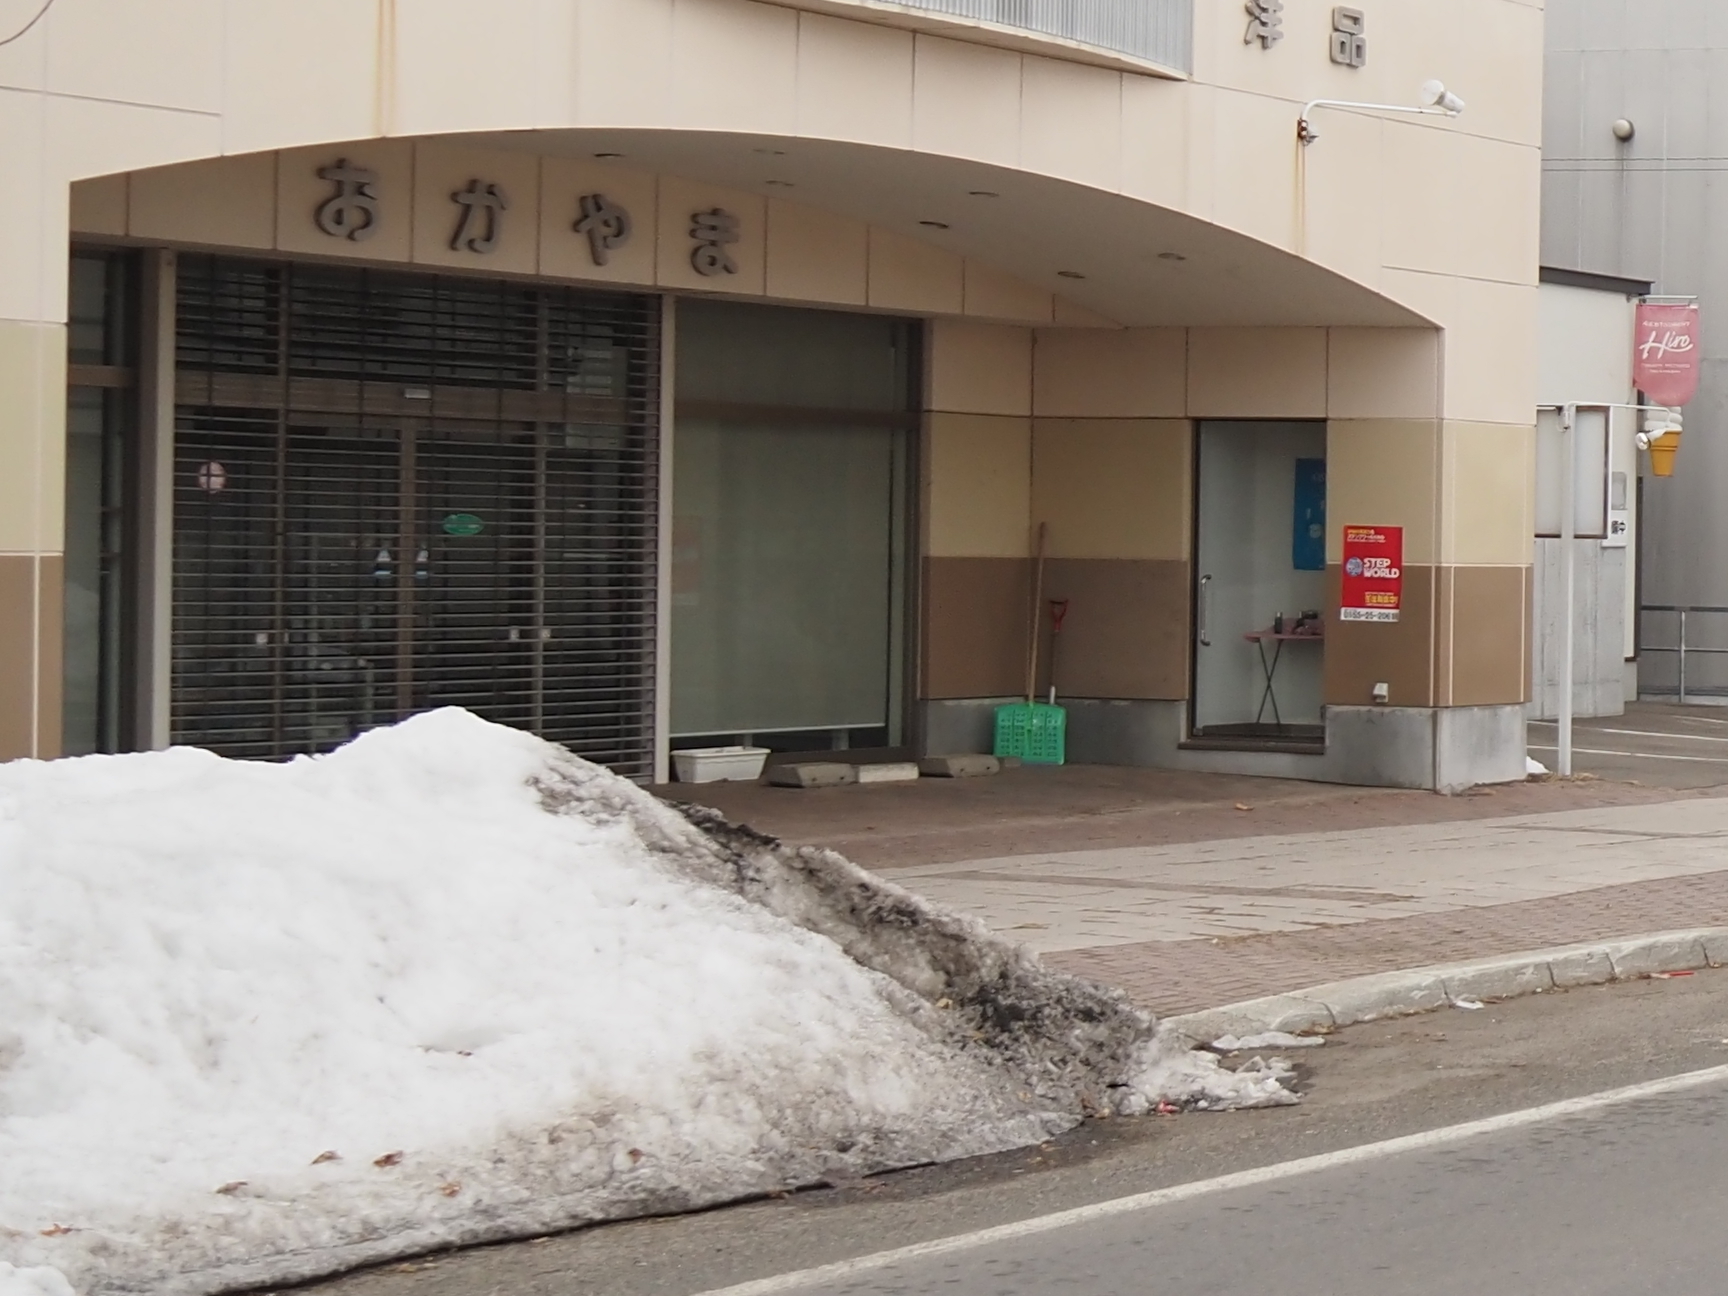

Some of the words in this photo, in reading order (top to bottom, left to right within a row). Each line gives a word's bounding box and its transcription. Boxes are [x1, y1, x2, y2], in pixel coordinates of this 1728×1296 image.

[1639, 331, 1694, 359] Hiro
[1363, 558, 1391, 568] STEP
[1363, 568, 1399, 578] WORLD
